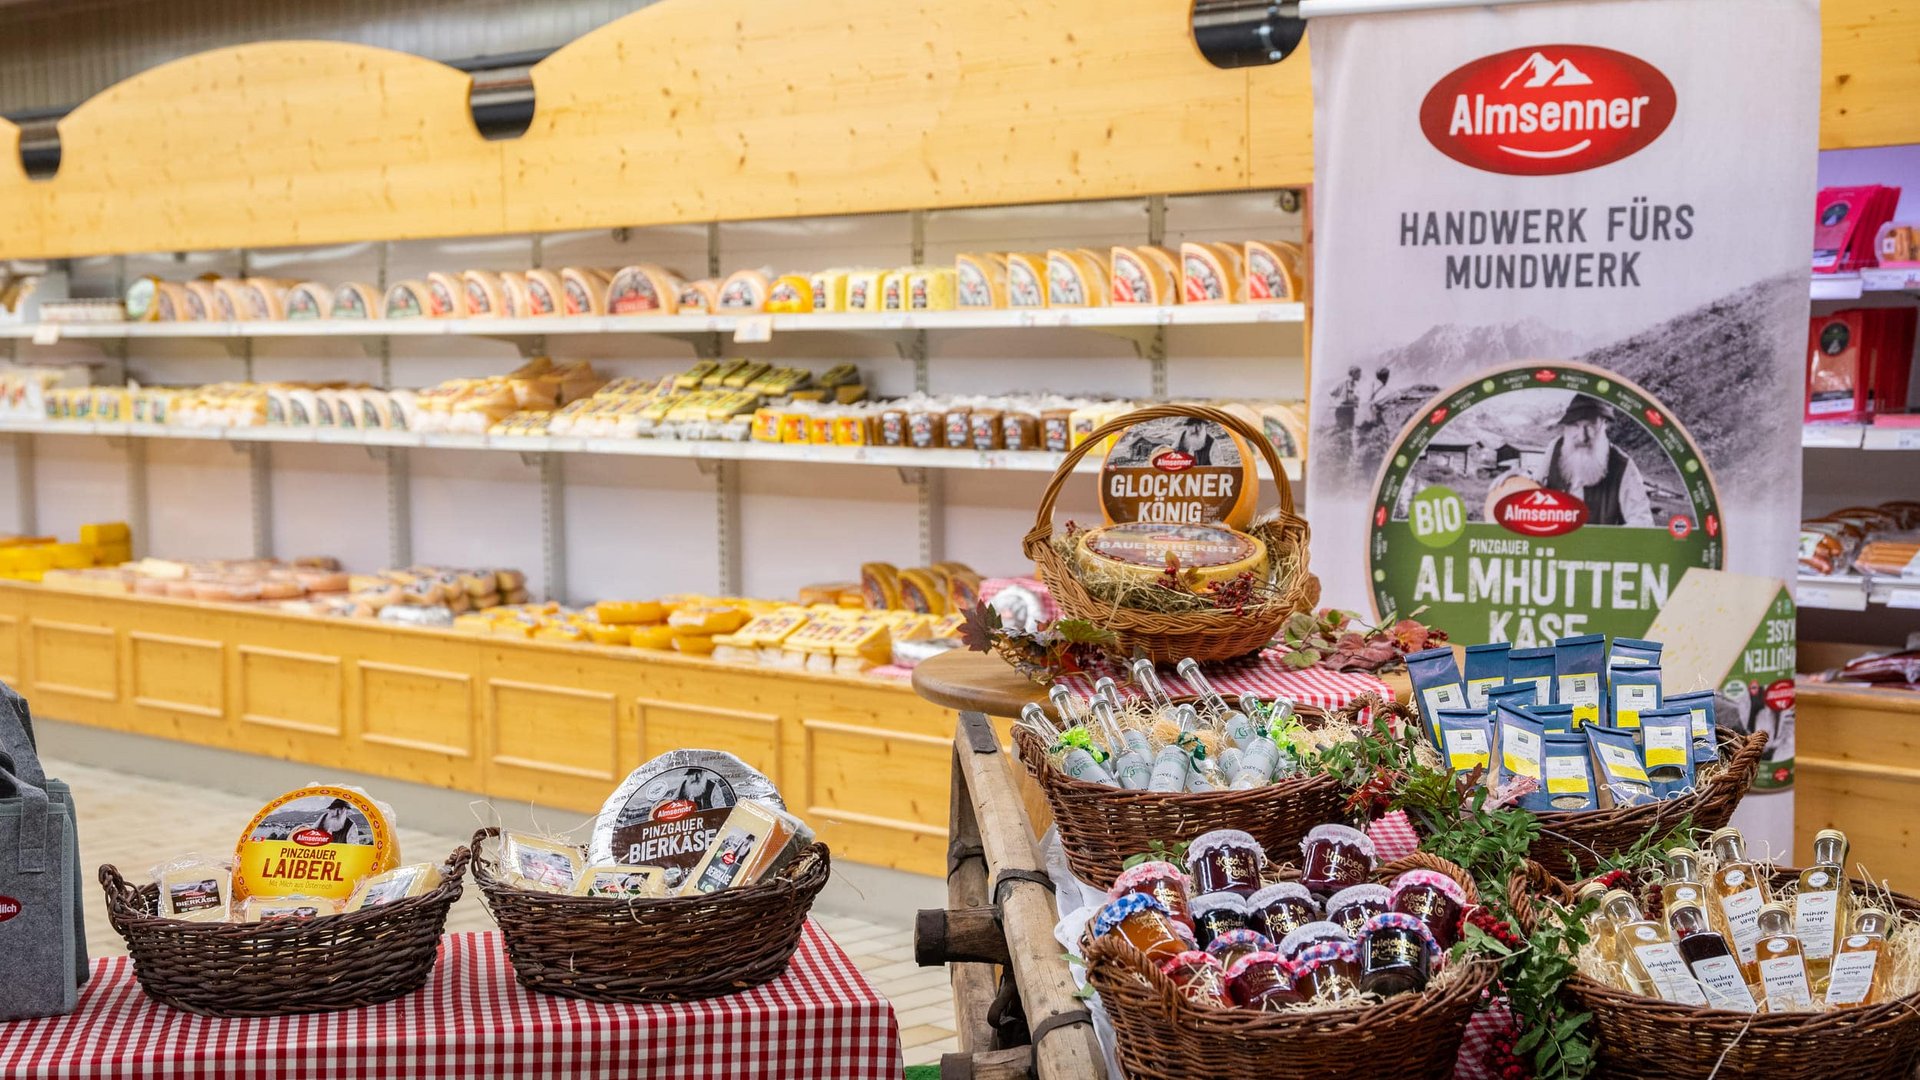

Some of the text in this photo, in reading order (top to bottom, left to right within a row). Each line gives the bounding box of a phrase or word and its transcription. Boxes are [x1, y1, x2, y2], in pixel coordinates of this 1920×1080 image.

[1450, 94, 1650, 136] Almsenner
[1400, 196, 1695, 247] HANDWERK FÜRS
[1445, 251, 1641, 290] MUNDWERK
[1156, 458, 1193, 468] Almsenner
[1110, 473, 1234, 498] GLOCKNER
[1137, 496, 1202, 523] KÖNIG
[1415, 495, 1462, 537] BIO
[1503, 504, 1580, 523] Almsenner
[1469, 538, 1531, 556] PINZGAUER
[1413, 546, 1670, 611] ALMHÜTTEN
[657, 805, 693, 818] Almsenner
[296, 834, 330, 843] Almsenner
[642, 817, 704, 840] PINZGAUER
[280, 847, 337, 860] PINZGAUER
[629, 828, 718, 864] BIERKÄSE
[262, 857, 345, 882] LAIBERL
[0, 903, 17, 913] ilch
[175, 895, 218, 907] BIERKÄSE
